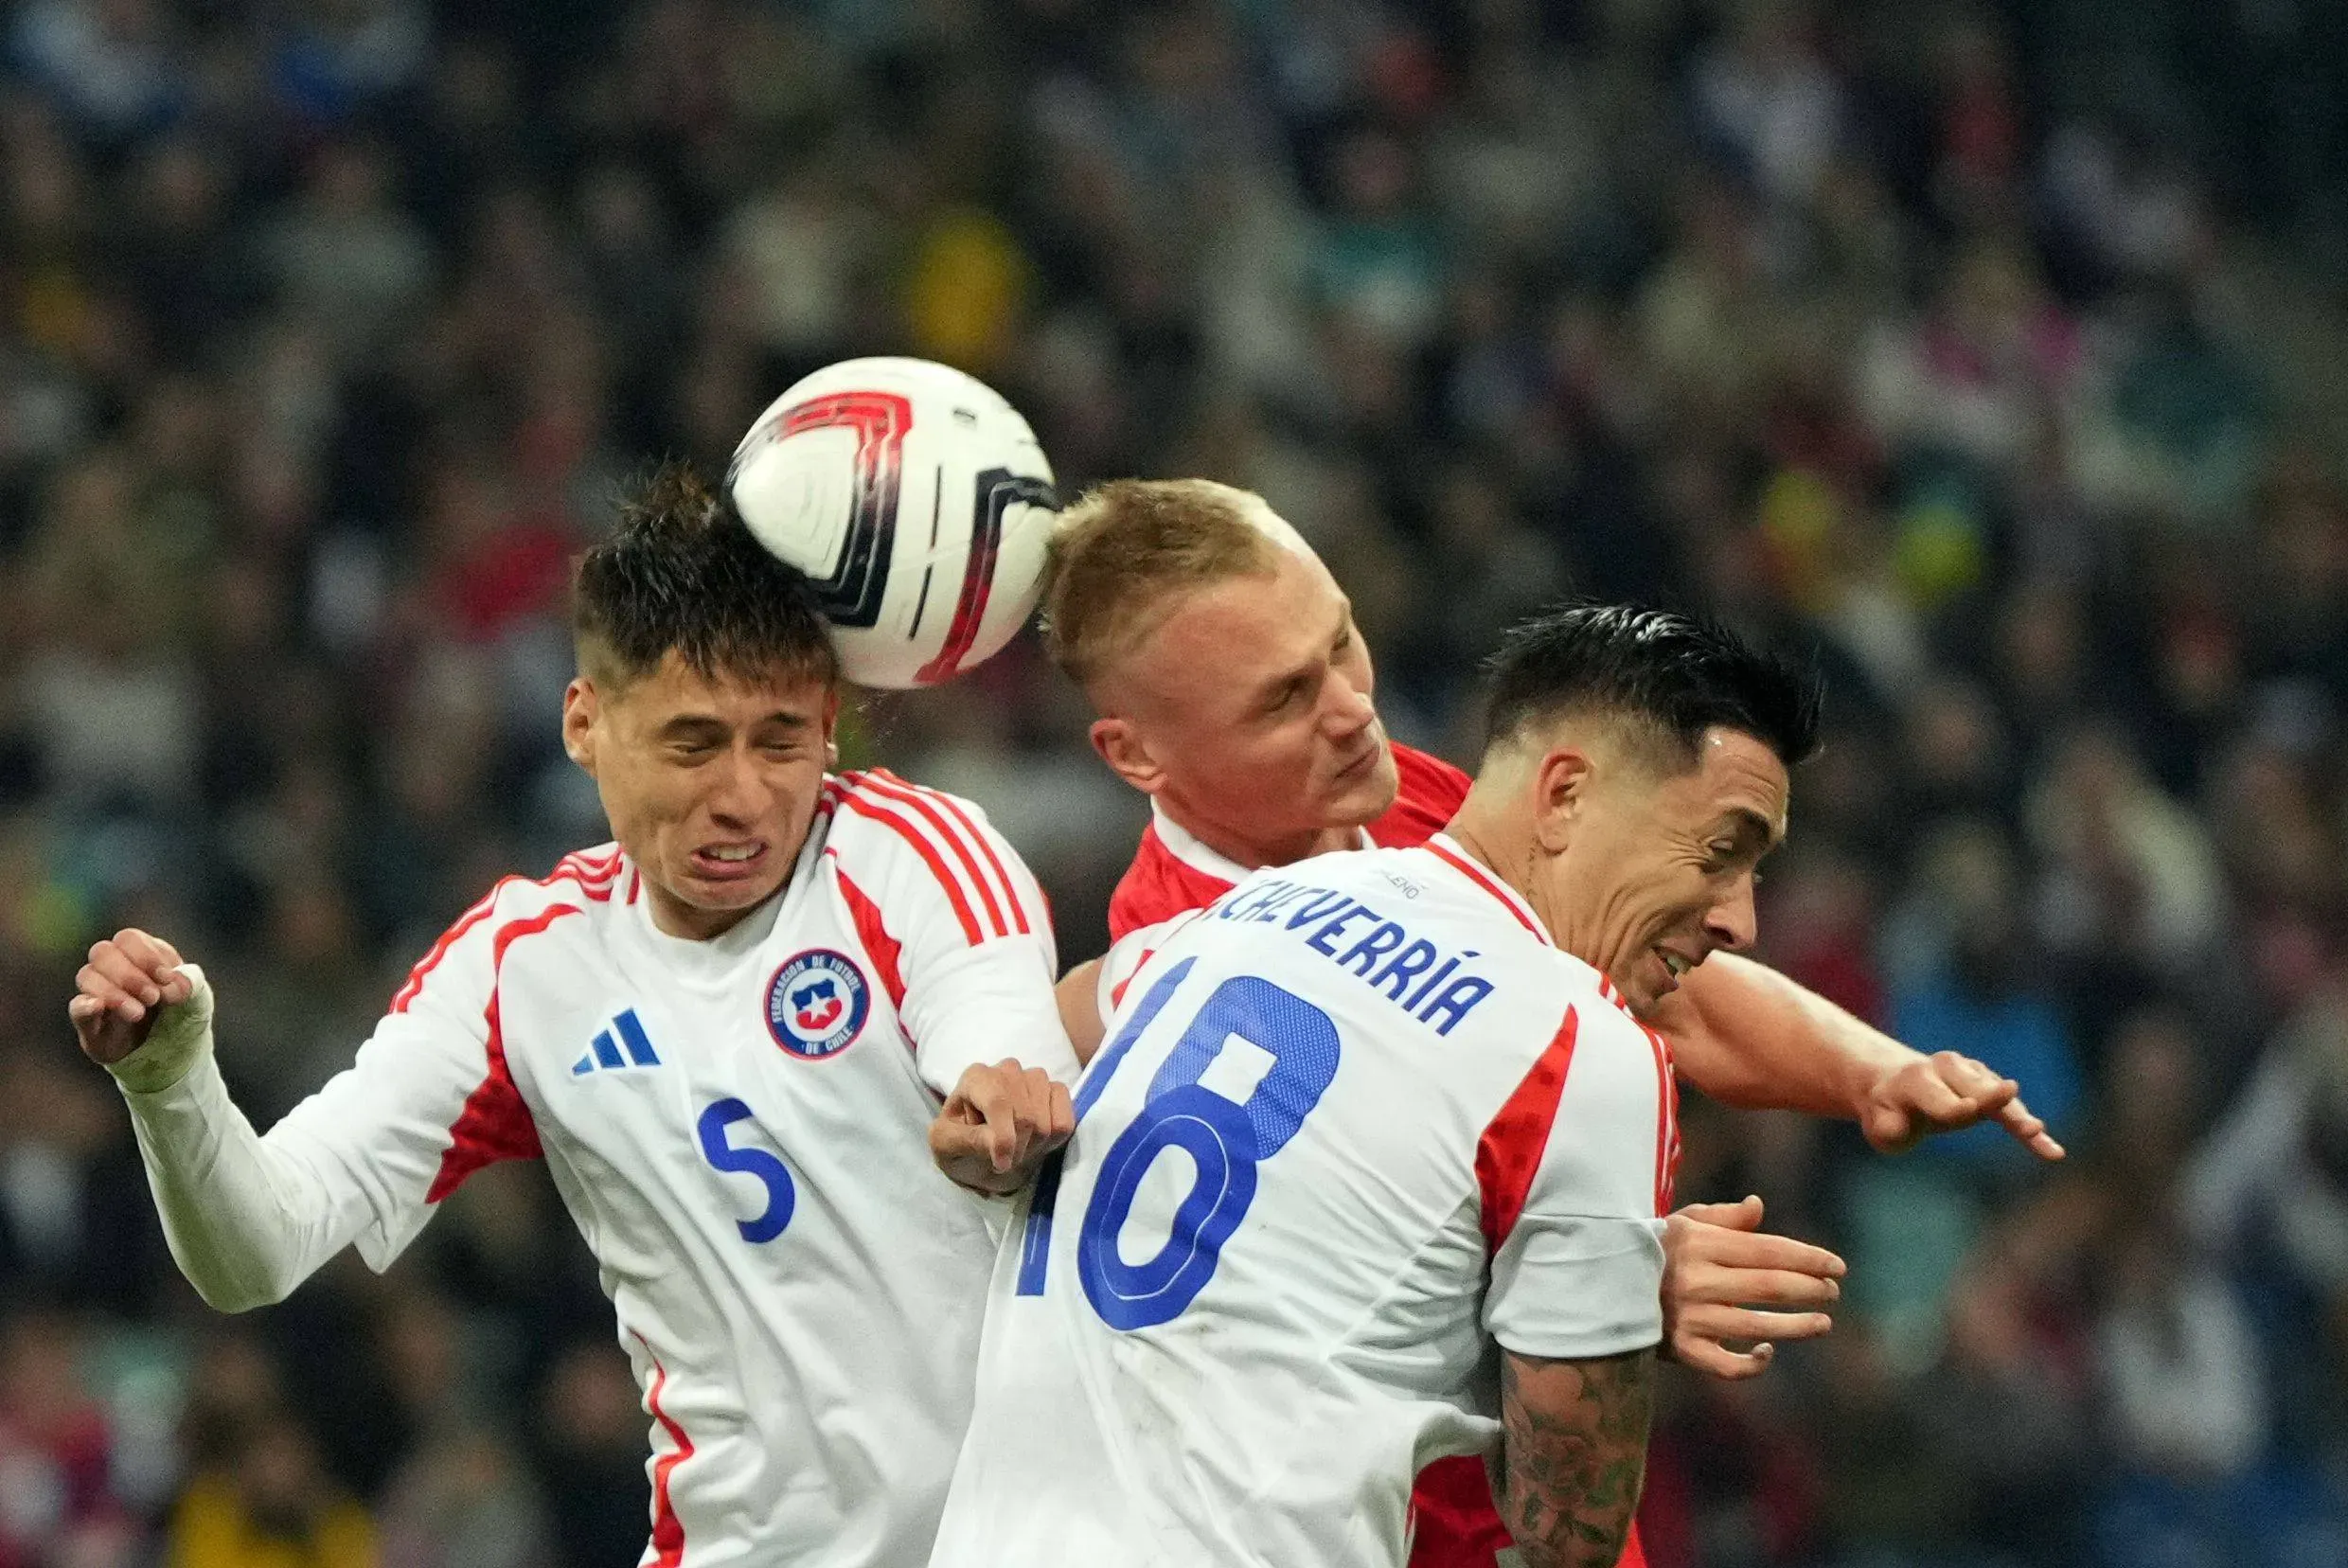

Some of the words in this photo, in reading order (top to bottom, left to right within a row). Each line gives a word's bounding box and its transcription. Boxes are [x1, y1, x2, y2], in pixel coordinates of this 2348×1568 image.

[811, 954, 827, 969] DE
[1202, 879, 1496, 1037] CHEVERRÍA
[805, 1041, 820, 1055] DE
[697, 1096, 795, 1243] 5
[1015, 955, 1341, 1332] 18
